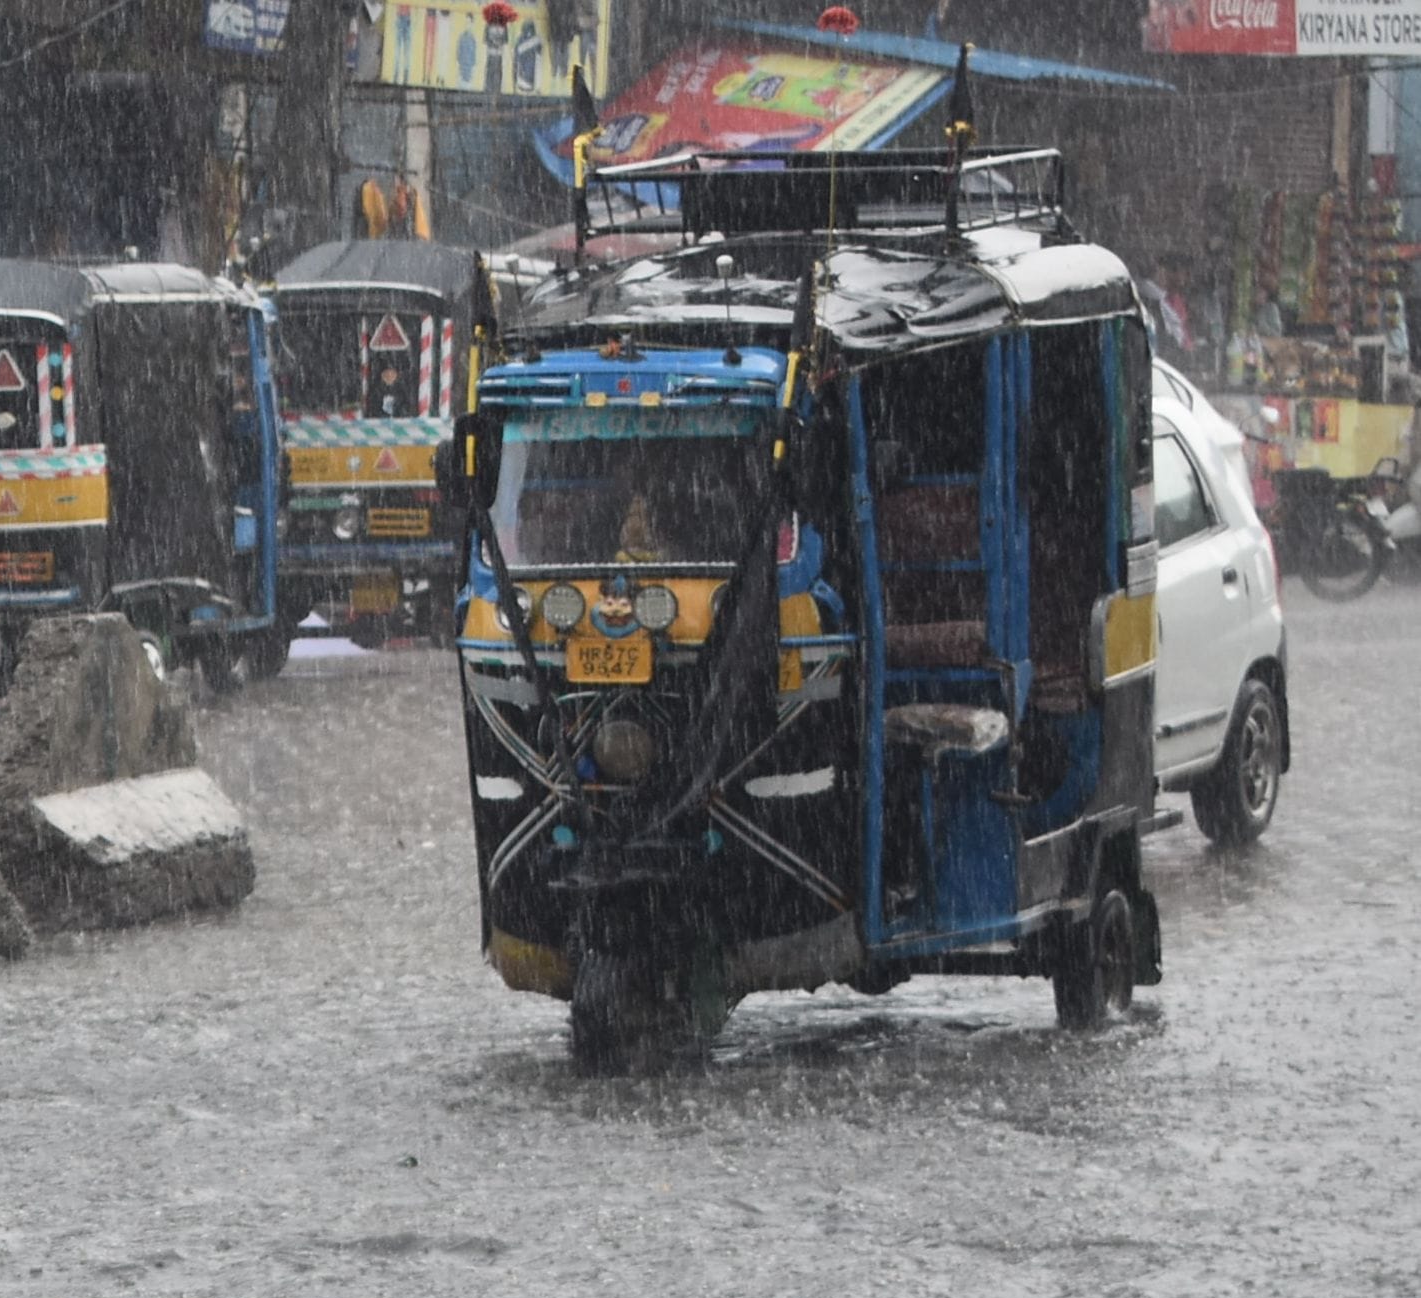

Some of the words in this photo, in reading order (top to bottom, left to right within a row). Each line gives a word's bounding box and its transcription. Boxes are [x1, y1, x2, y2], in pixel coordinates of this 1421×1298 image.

[1299, 14, 1367, 44] KIRYANA
[1373, 13, 1421, 44] STORE
[583, 662, 636, 675] 9547
